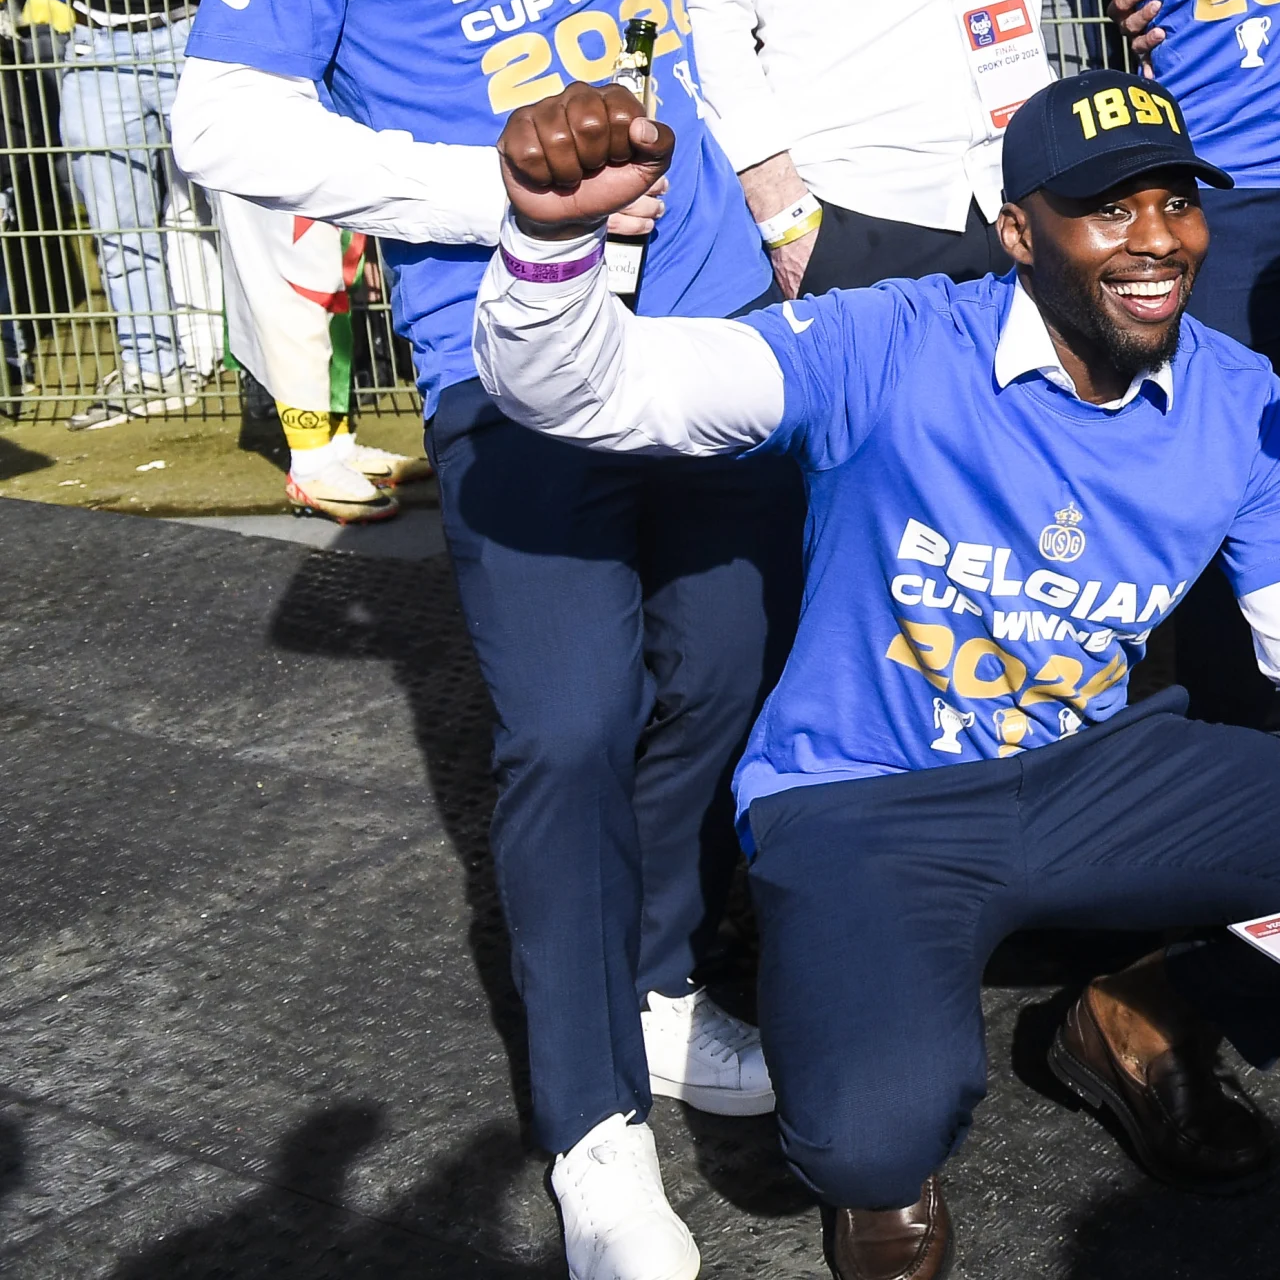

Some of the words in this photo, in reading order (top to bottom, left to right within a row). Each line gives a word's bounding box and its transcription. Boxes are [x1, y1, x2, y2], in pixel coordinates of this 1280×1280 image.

[977, 59, 1003, 74] CROKY
[1005, 52, 1021, 65] CUP
[1021, 47, 1040, 60] 2024
[995, 43, 1018, 57] FINAL
[1072, 86, 1181, 140] 1897
[897, 517, 1188, 624] BELGIAN
[891, 574, 983, 617] CUP
